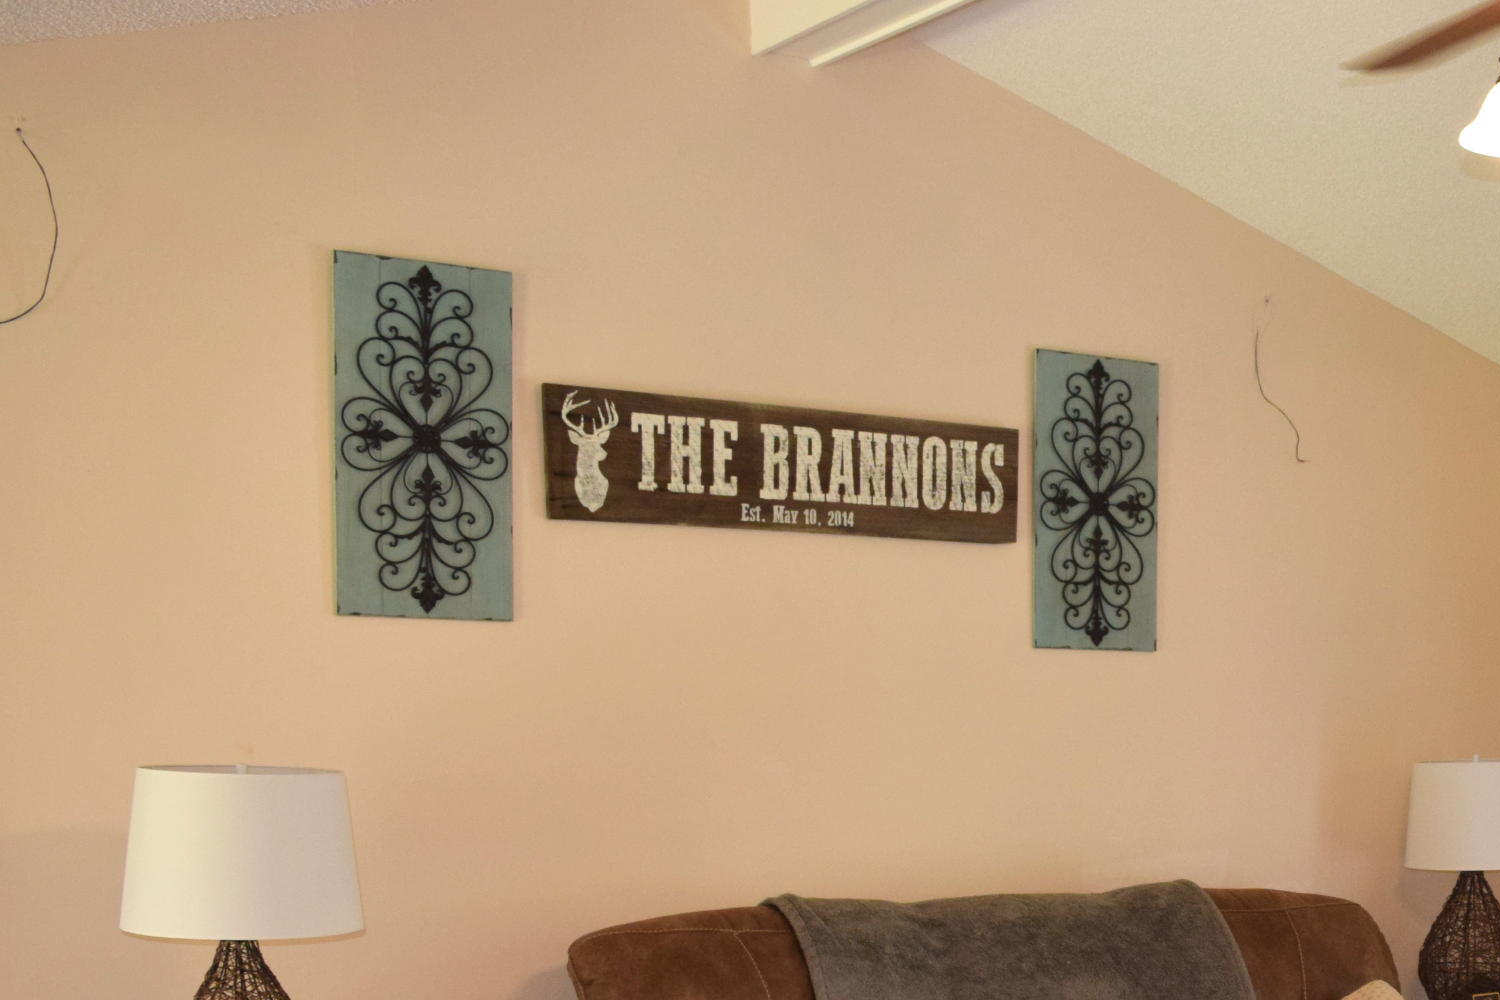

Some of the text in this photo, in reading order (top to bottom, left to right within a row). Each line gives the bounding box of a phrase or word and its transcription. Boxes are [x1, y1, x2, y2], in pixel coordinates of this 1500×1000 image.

[631, 411, 1005, 514] THE BRANNONS
[741, 502, 766, 523] Est.
[772, 505, 799, 525] May
[827, 510, 855, 528] 2014
